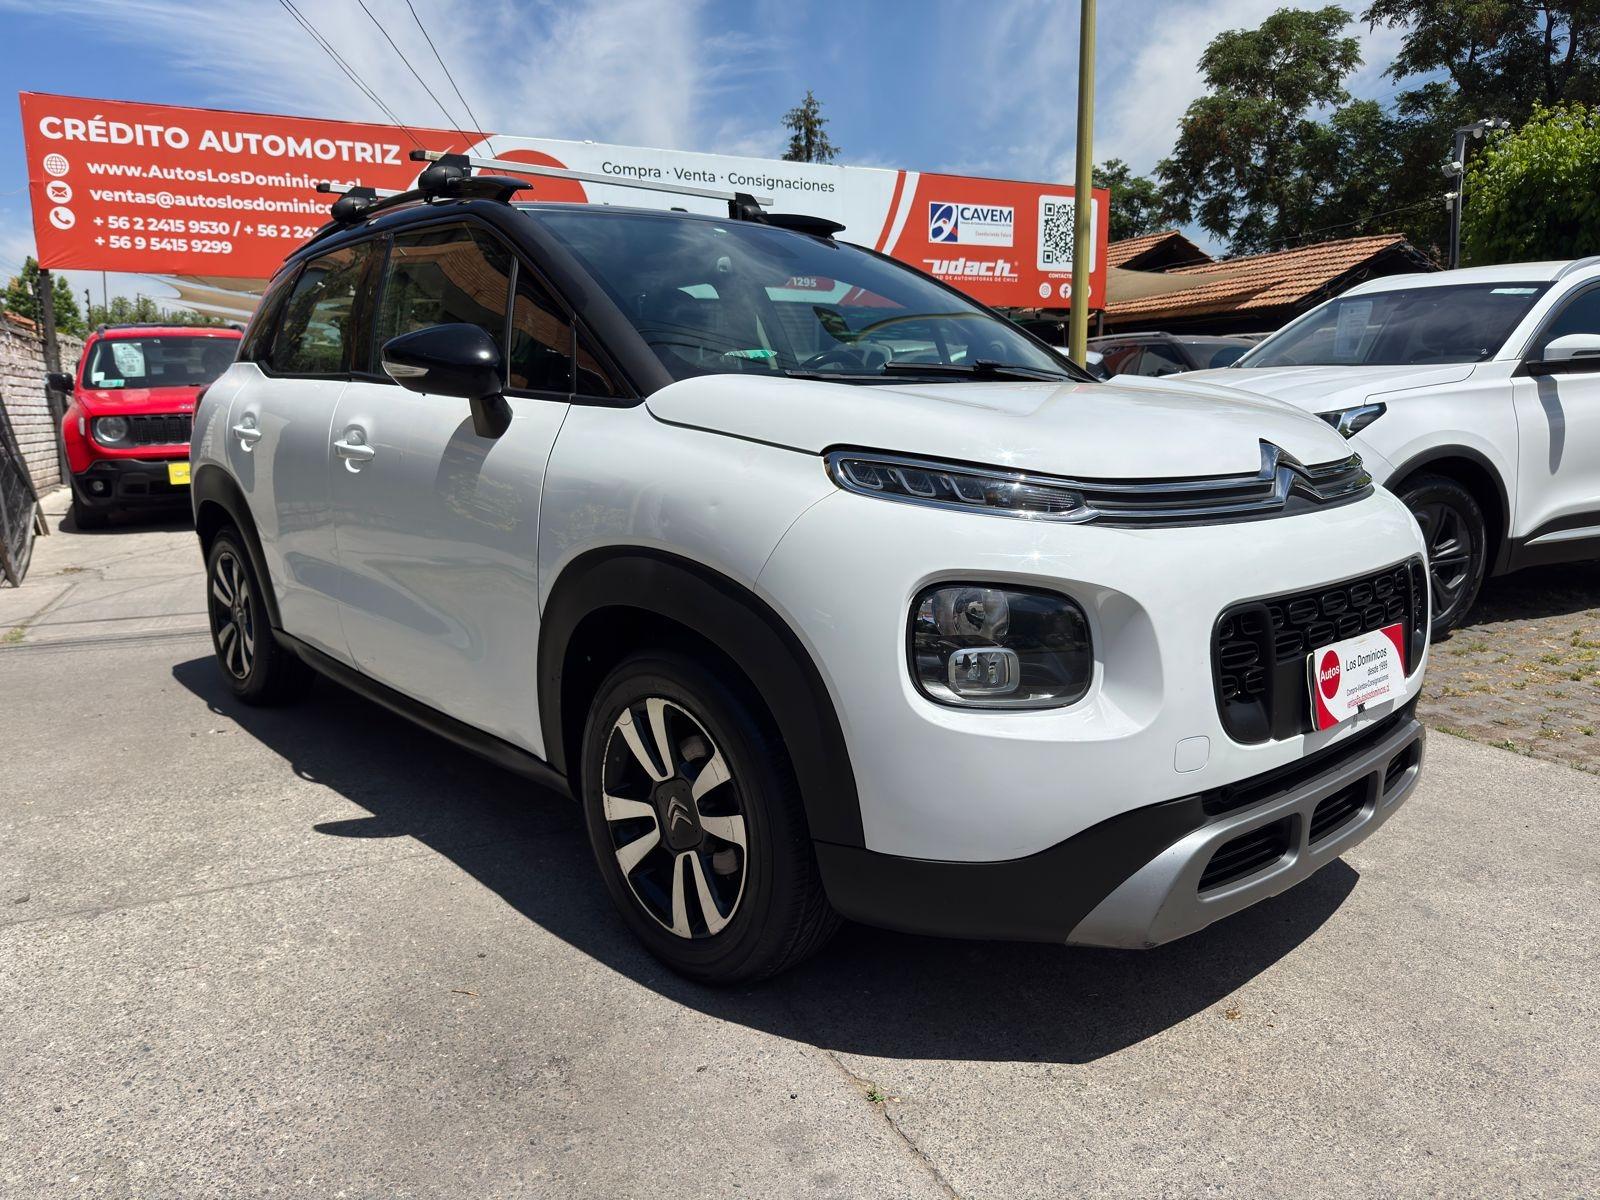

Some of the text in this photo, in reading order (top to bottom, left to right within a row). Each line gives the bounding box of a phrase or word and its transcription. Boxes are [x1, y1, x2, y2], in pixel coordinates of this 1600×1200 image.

[39, 114, 402, 166] CRÉDITO AUTOMOTRIZ
[86, 162, 361, 189] www.AutosLosDominiccl
[601, 161, 661, 179] Compra
[673, 167, 716, 183] Venta
[728, 172, 835, 193] Consignaciones
[960, 207, 1012, 223] CAVEM
[107, 216, 130, 230] 56
[132, 217, 145, 231] 2
[147, 218, 186, 233] 2415
[188, 220, 230, 235] 9530
[257, 224, 278, 238] 56
[280, 225, 291, 238] 2
[109, 235, 132, 249] 56
[134, 236, 147, 250] 9
[149, 237, 188, 252] 5415
[190, 239, 233, 254] 9299
[791, 276, 817, 288] 1295
[1345, 648, 1388, 672] Los Dominicos
[1320, 665, 1340, 683] Autos
